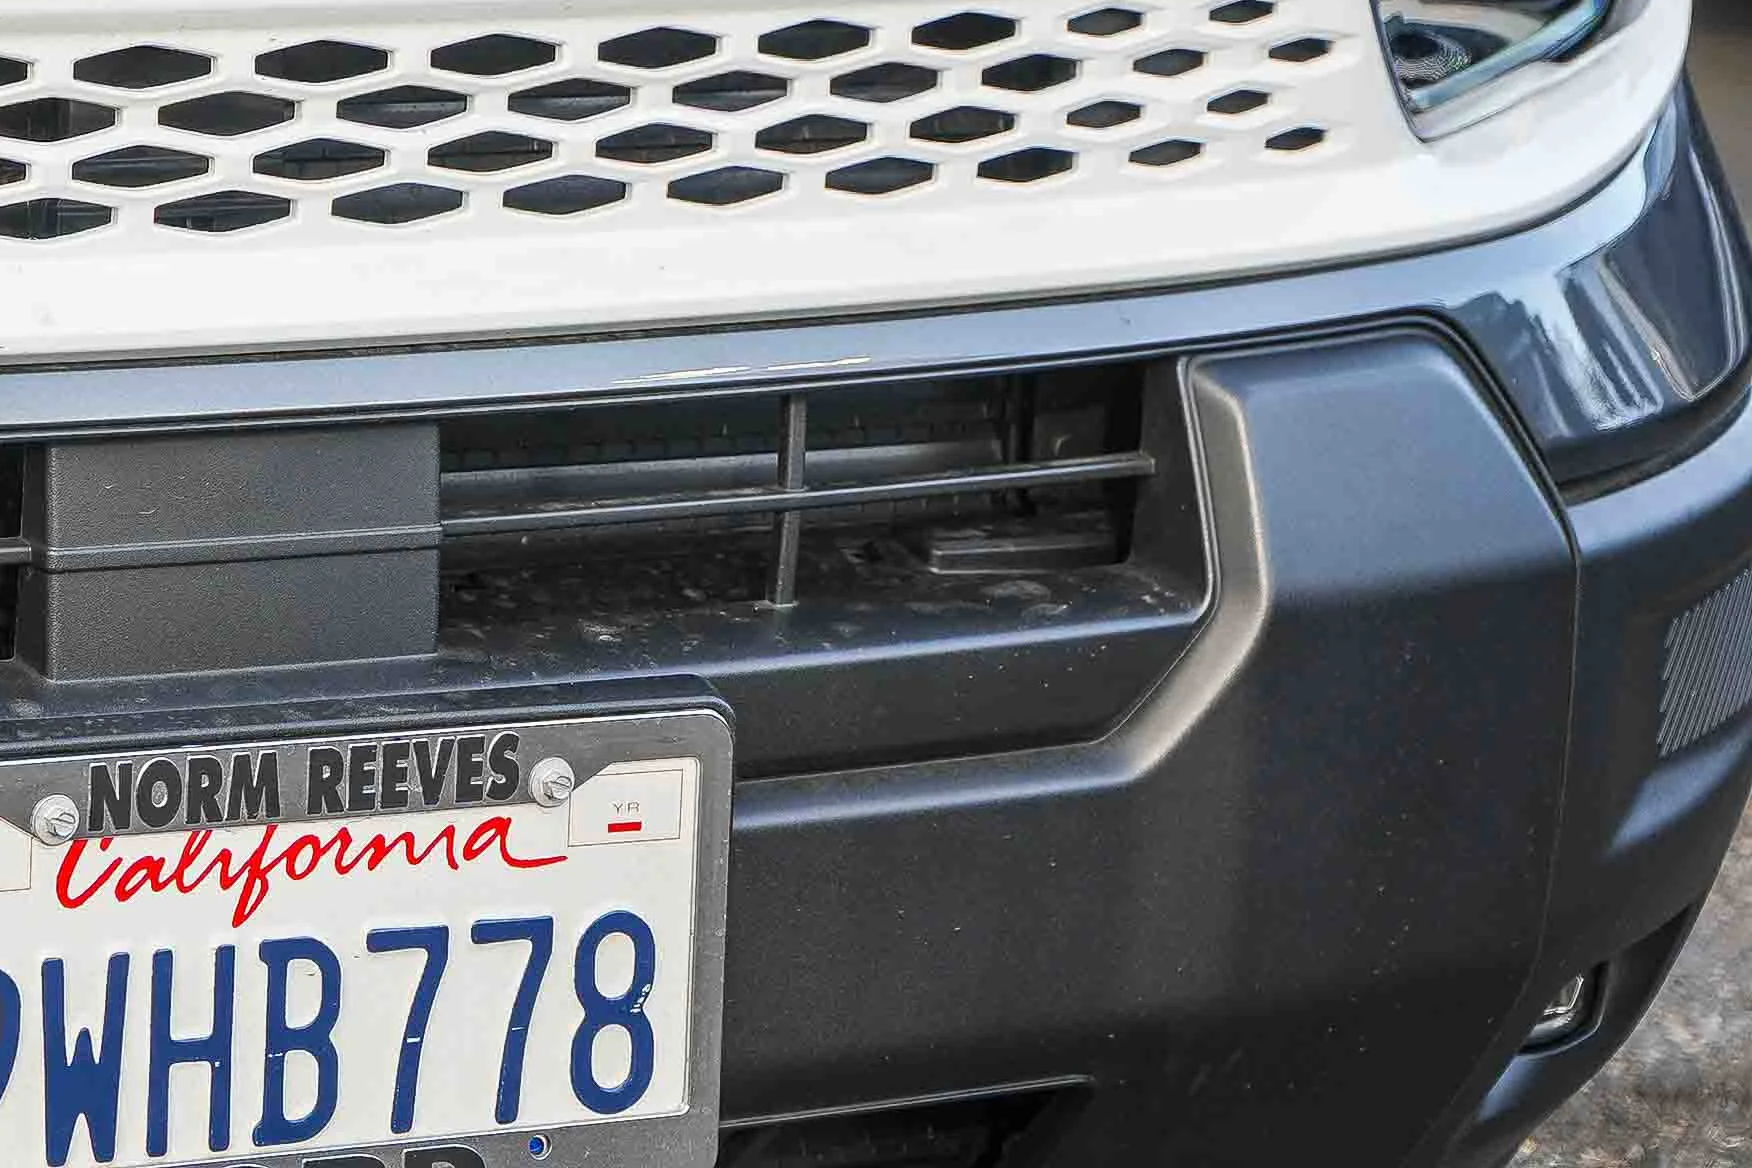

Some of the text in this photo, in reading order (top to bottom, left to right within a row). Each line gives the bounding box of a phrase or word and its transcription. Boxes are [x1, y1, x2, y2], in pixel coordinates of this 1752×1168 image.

[86, 732, 522, 832] NORM REEVES
[612, 799, 641, 815] YR
[55, 814, 569, 929] California
